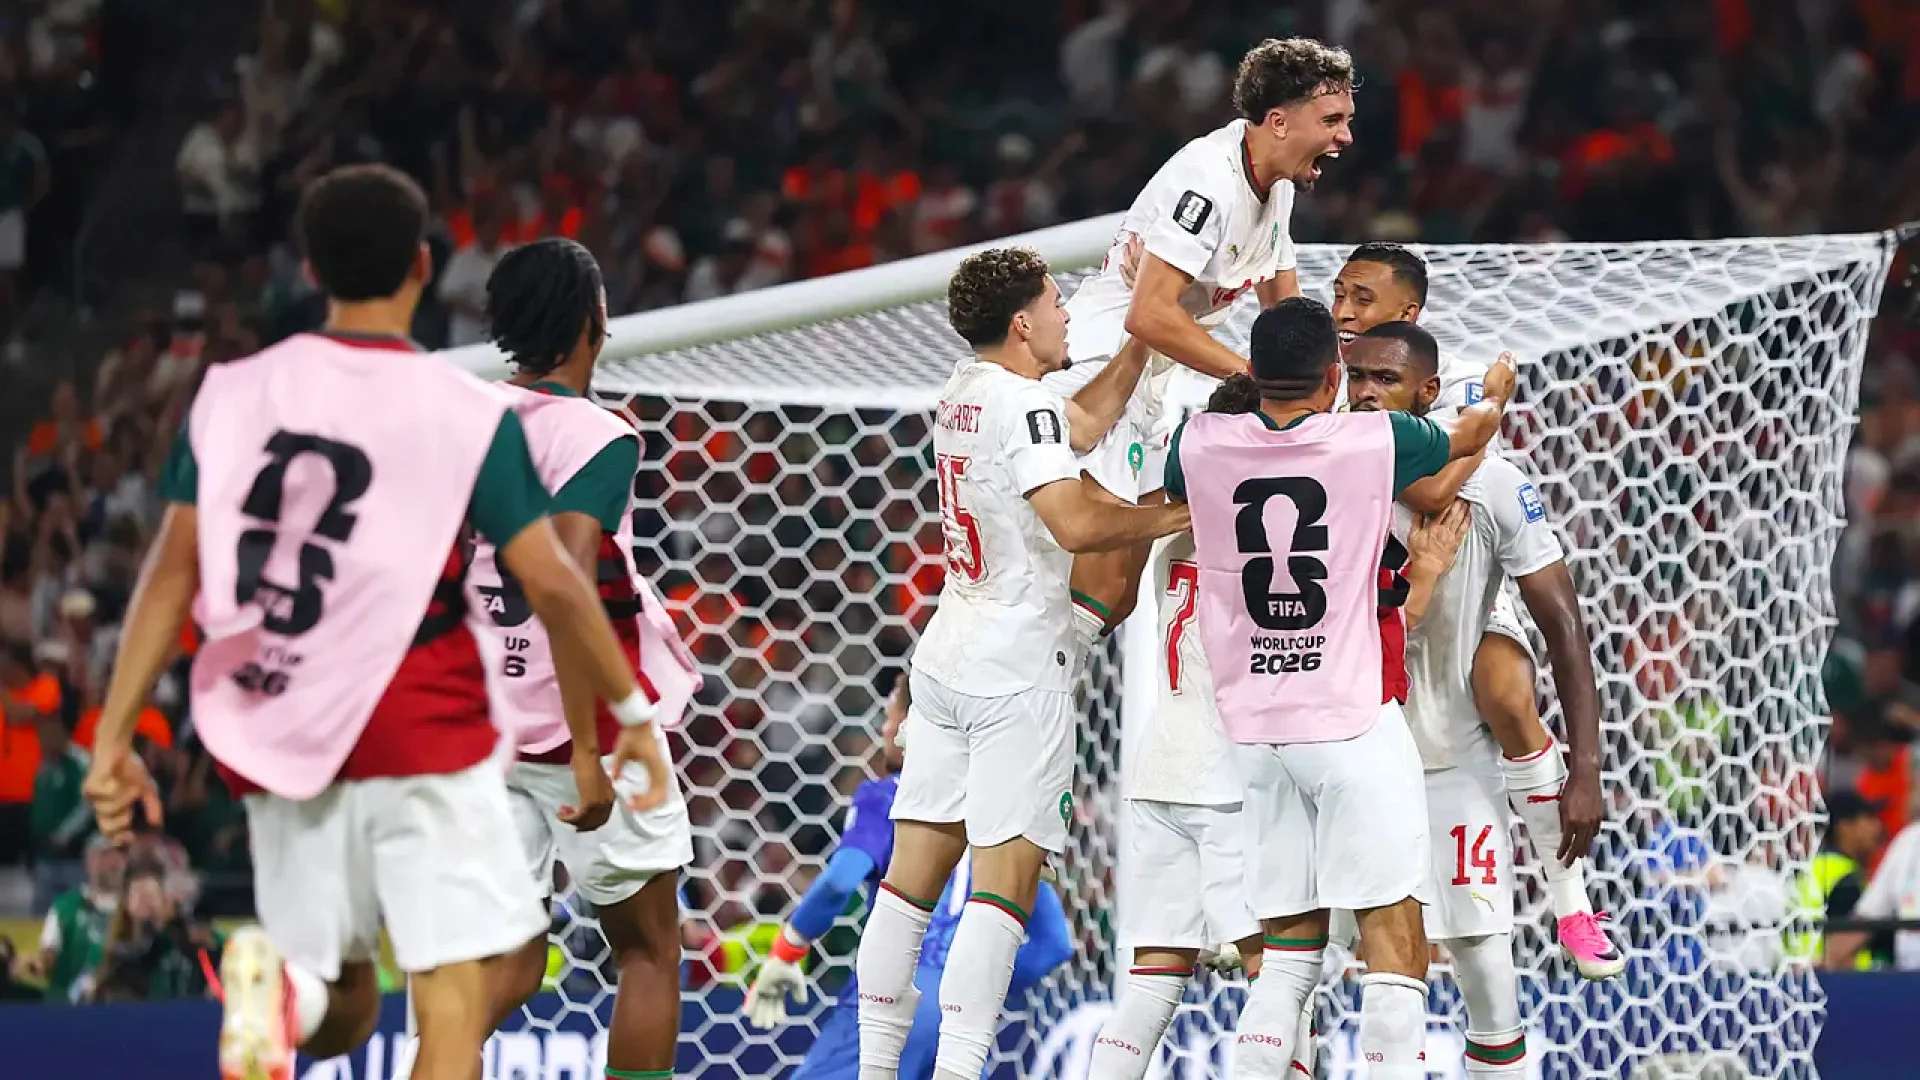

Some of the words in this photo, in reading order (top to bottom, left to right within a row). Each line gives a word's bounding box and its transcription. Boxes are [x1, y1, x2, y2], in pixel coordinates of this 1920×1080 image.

[1268, 601, 1307, 617] FIFA
[1165, 559, 1198, 696] 7
[505, 636, 530, 651] UP
[1296, 636, 1326, 650] CUP
[1251, 652, 1322, 674] 2026
[1450, 825, 1497, 885] 14
